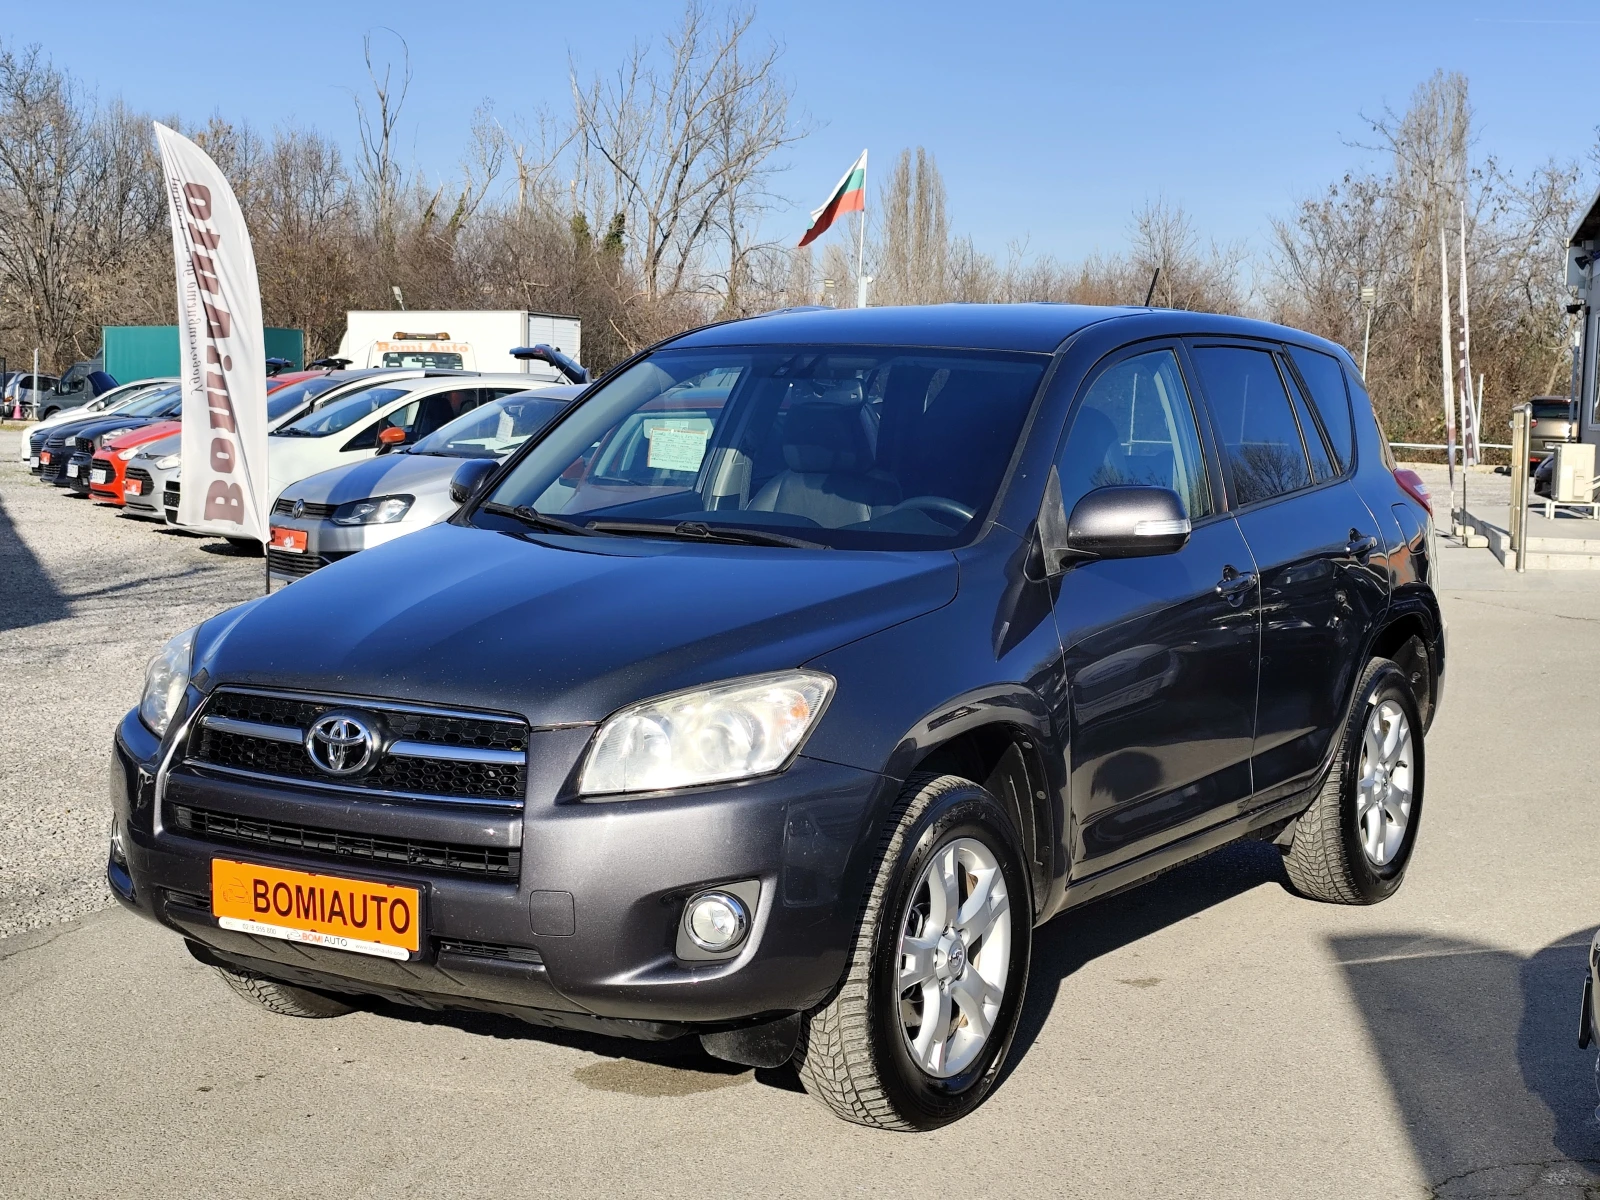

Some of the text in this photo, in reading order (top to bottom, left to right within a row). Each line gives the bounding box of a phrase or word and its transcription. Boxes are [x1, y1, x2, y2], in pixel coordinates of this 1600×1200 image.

[377, 341, 469, 352] Bomi Auto
[253, 878, 410, 934] BOMIAUTO
